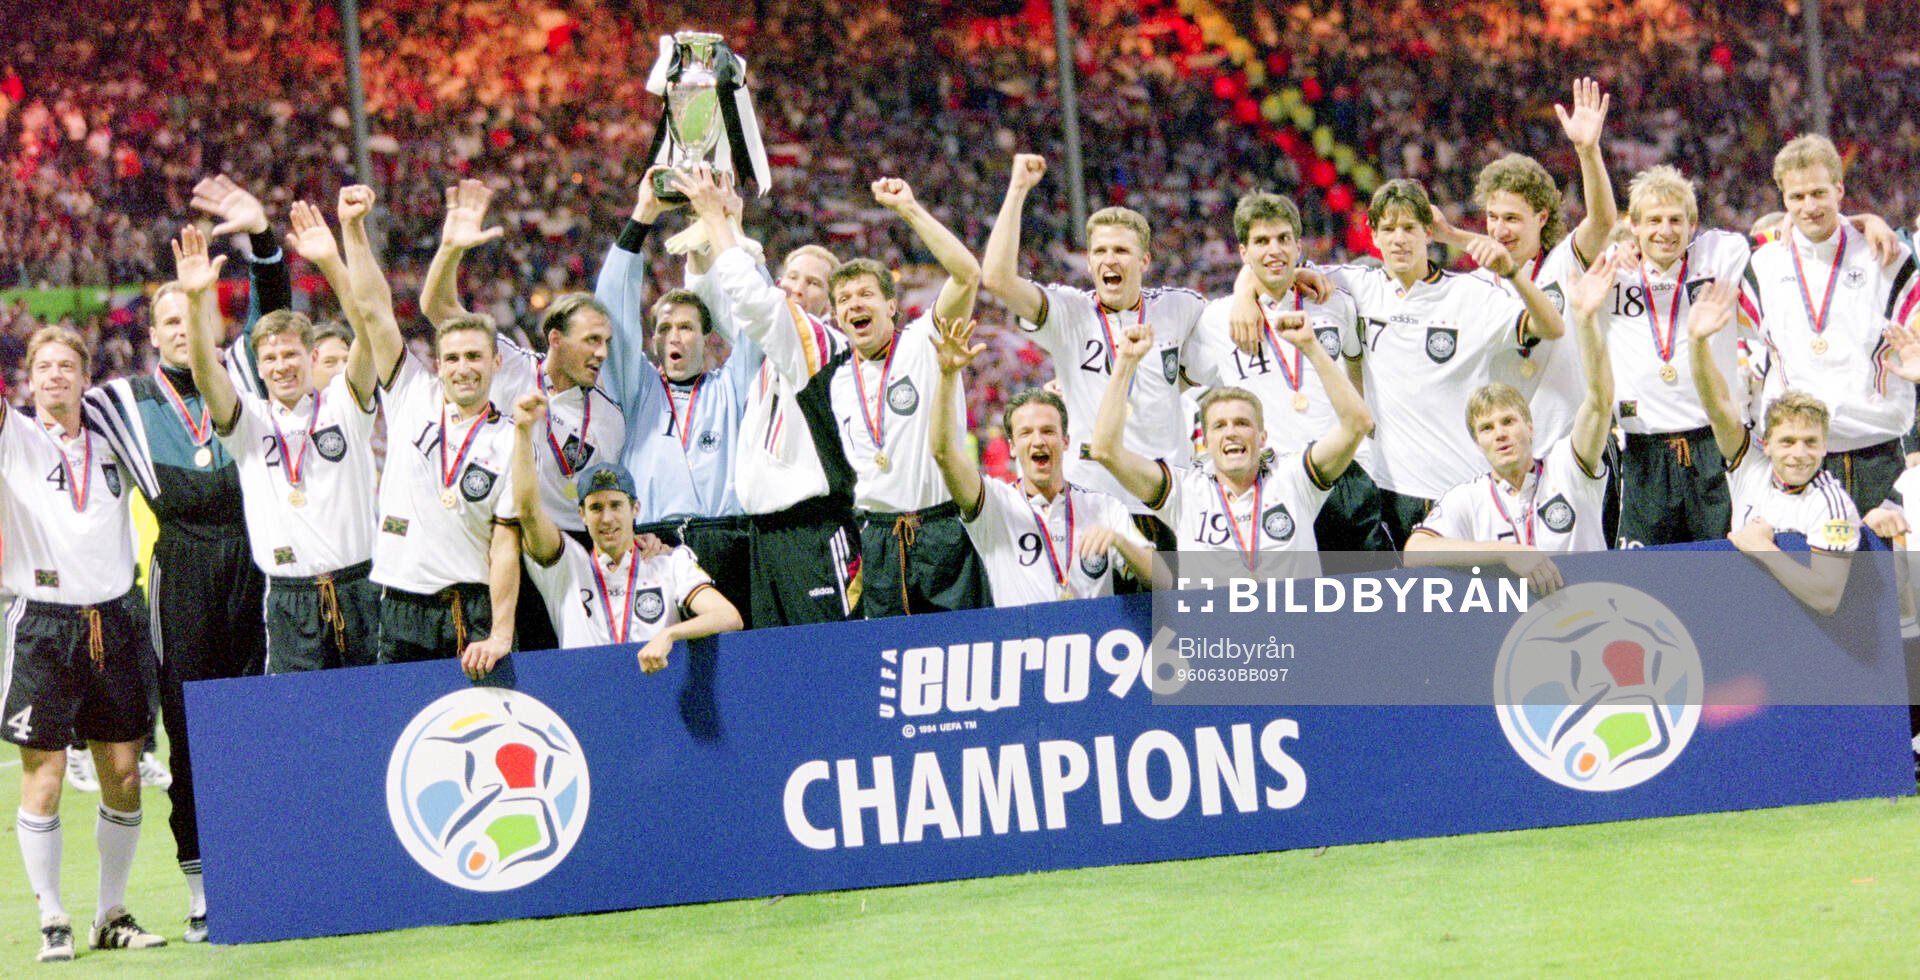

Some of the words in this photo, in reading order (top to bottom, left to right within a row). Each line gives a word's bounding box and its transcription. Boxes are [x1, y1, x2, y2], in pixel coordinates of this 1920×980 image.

[1611, 282, 1645, 317] 18
[1389, 314, 1420, 325] adidas
[1230, 341, 1271, 380] 14
[262, 434, 281, 468] 2
[46, 461, 68, 491] 4
[1194, 508, 1231, 546] 19
[1018, 532, 1043, 566] 9
[808, 586, 835, 597] adidas
[879, 649, 898, 719] UEFA
[7, 704, 33, 741] 4
[939, 722, 962, 732] UEFA
[963, 720, 977, 730] TM
[783, 718, 1307, 850] CHAMPIONS
